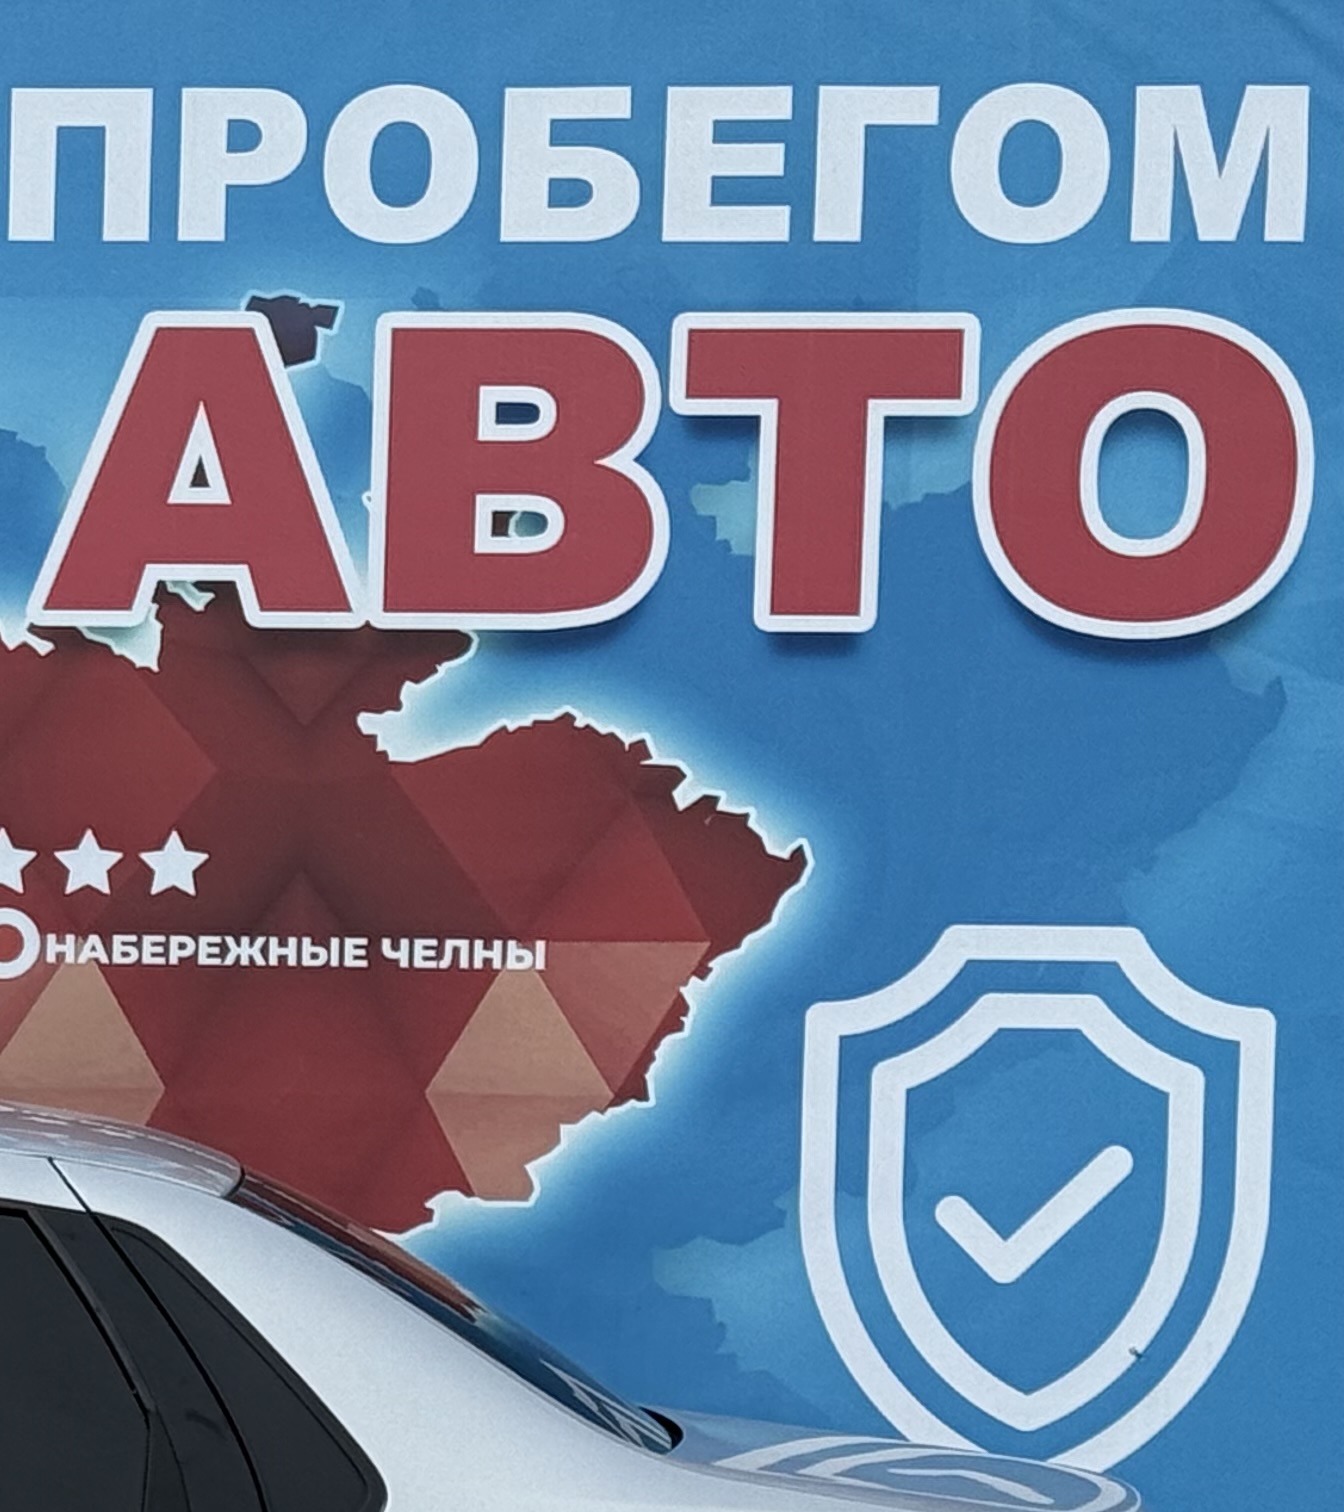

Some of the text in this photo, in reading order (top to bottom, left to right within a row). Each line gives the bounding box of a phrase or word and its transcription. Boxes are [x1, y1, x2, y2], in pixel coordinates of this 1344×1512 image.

[7, 83, 1312, 246] ПРОБЕГОМ
[28, 308, 1316, 640] АВТО
[45, 933, 547, 971] НАБЕРЕЖНЫЕ ЧЕЛНЫ
